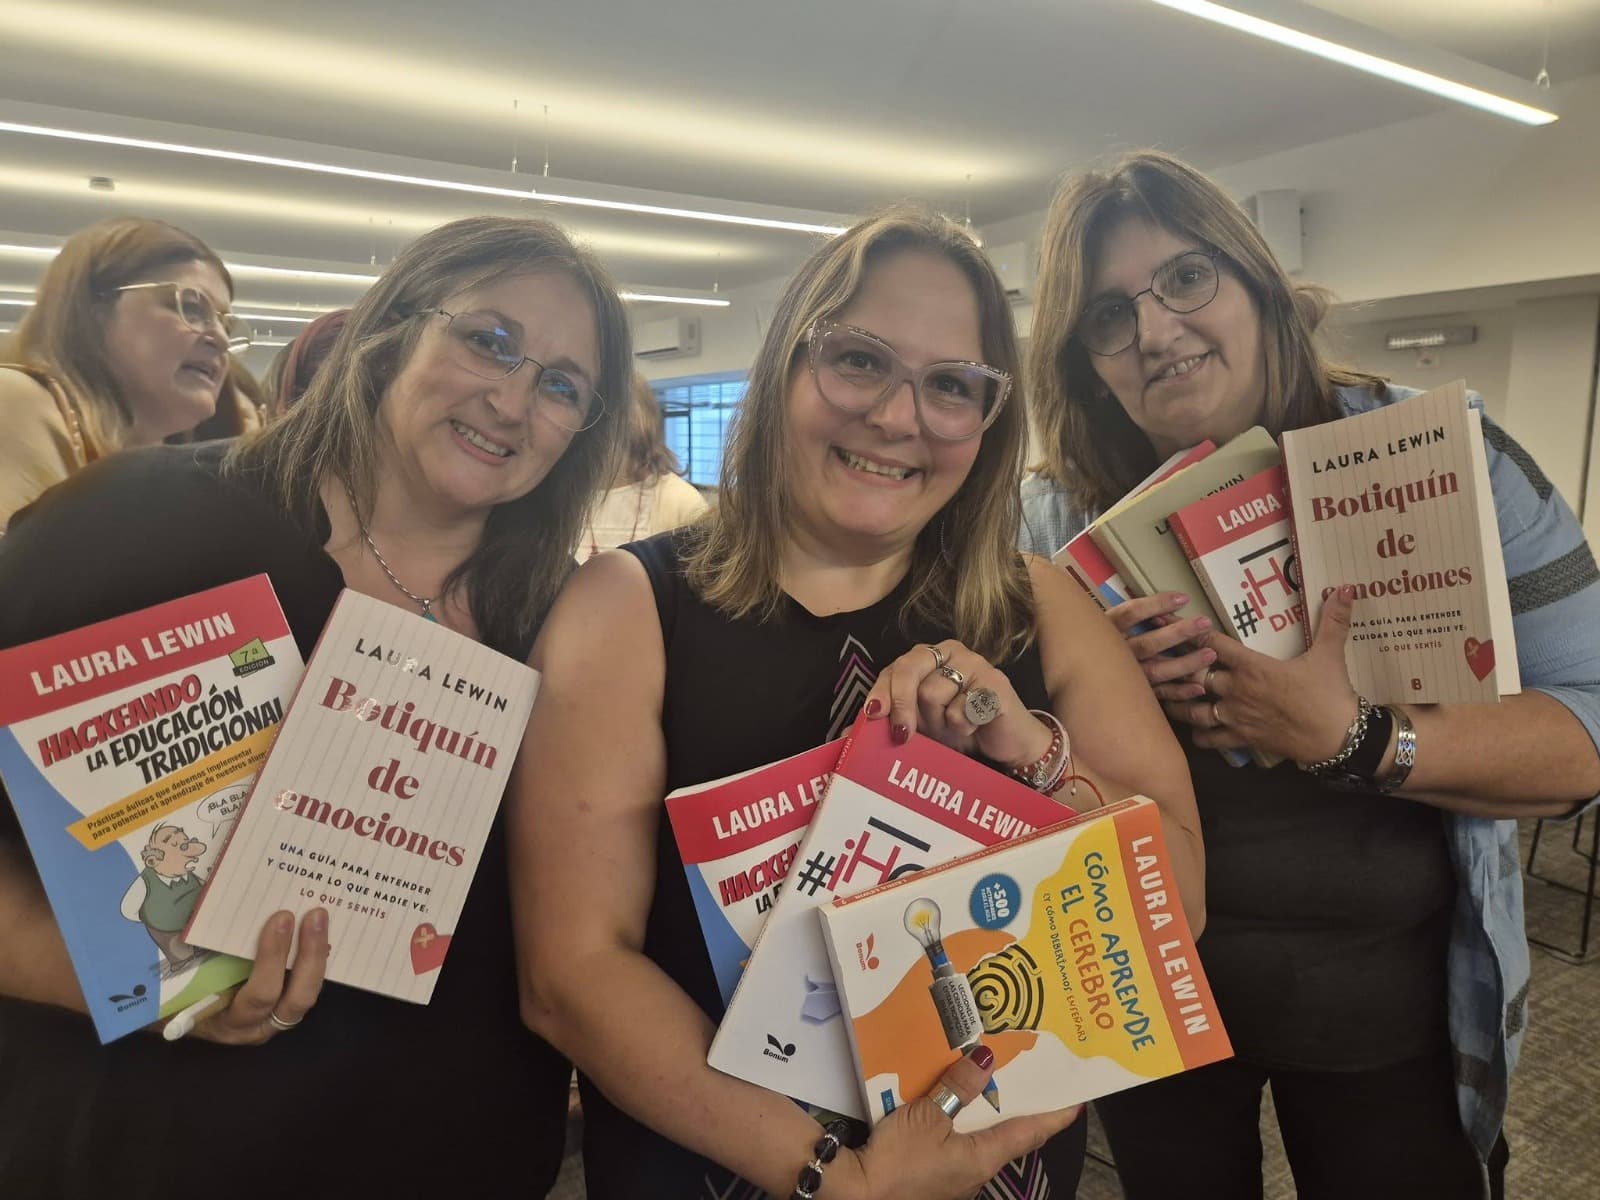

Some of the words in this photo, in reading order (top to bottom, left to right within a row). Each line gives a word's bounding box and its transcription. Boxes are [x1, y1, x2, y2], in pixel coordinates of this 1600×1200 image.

[1313, 448, 1379, 473] LAURA
[1387, 426, 1445, 456] LEWIN
[1216, 493, 1281, 533] LAURA
[1309, 469, 1460, 523] Botiquín
[1376, 528, 1416, 559] de
[1352, 632, 1389, 641] CUIDAR
[1392, 630, 1403, 638] LO
[1406, 629, 1423, 638] QUE
[1395, 615, 1417, 624] PARA
[30, 645, 138, 697] LAURA
[141, 611, 236, 661] LEWIN
[1393, 643, 1411, 652] QUE
[441, 673, 508, 713] LEWIN
[38, 674, 202, 768] HACKEANDO
[86, 751, 108, 773] LA
[109, 684, 243, 767] EDUCACIÓN
[318, 676, 498, 770] Botiquín
[87, 808, 125, 831] Prácticas
[155, 786, 170, 799] que
[172, 770, 206, 791] debemos
[207, 748, 252, 773] implementar
[92, 826, 111, 840] para
[112, 807, 149, 832] potenciar
[150, 801, 159, 811] el
[160, 781, 204, 806] aprendizaje
[205, 776, 215, 785] de
[215, 761, 247, 780] nuestros
[367, 758, 420, 800] de
[887, 759, 965, 816] LAURA
[273, 789, 466, 868] emociones
[712, 790, 795, 841] LAURA
[266, 858, 274, 867] Y
[278, 862, 323, 881] CUIDAR
[327, 876, 342, 887] LO
[346, 882, 370, 896] QUE
[373, 891, 409, 907] NADIE
[279, 842, 303, 857] UNA
[309, 851, 336, 867] GUÍA
[341, 862, 369, 878] PARA
[374, 872, 432, 896] ENTENDER
[718, 840, 802, 908] HACKEA
[299, 887, 314, 898] LO
[319, 893, 343, 907] QUE
[347, 901, 386, 919] SENTÍS
[755, 890, 773, 915] LA
[993, 882, 1010, 918] +500
[1045, 905, 1056, 930] CÓMO
[1060, 883, 1085, 914] EL
[856, 942, 866, 971] Bonum
[1083, 851, 1114, 923] CÓMO
[1101, 932, 1155, 1052] APRENDE
[1132, 835, 1173, 931] LAURA
[1158, 939, 1210, 1036] LEWIN
[1050, 933, 1073, 992] DEBERÍAMOS
[1068, 918, 1114, 1031] CEREBRO
[1066, 995, 1087, 1042] ENSEÑAR)
[763, 1048, 789, 1063] Bonum
